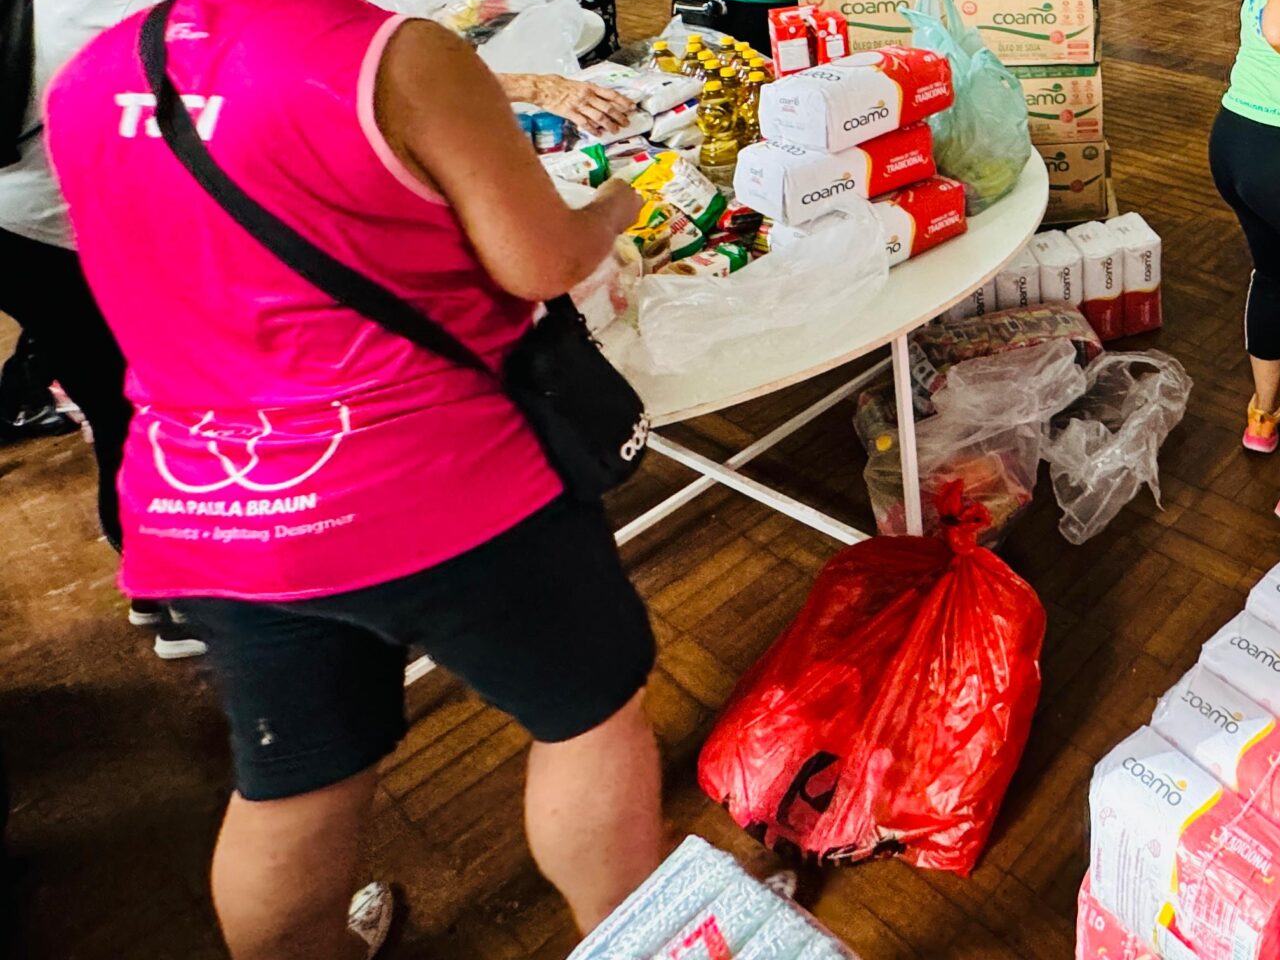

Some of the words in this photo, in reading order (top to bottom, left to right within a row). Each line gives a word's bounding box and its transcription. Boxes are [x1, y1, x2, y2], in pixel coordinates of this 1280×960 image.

[841, 0, 909, 16] coamo
[992, 12, 1057, 25] coamo
[1026, 91, 1066, 105] amo
[843, 106, 889, 132] coamo
[801, 178, 855, 206] coamo
[148, 498, 186, 514] ANA
[186, 500, 243, 516] PAULA
[246, 493, 318, 516] BRAUN
[1122, 756, 1182, 807] coamo
